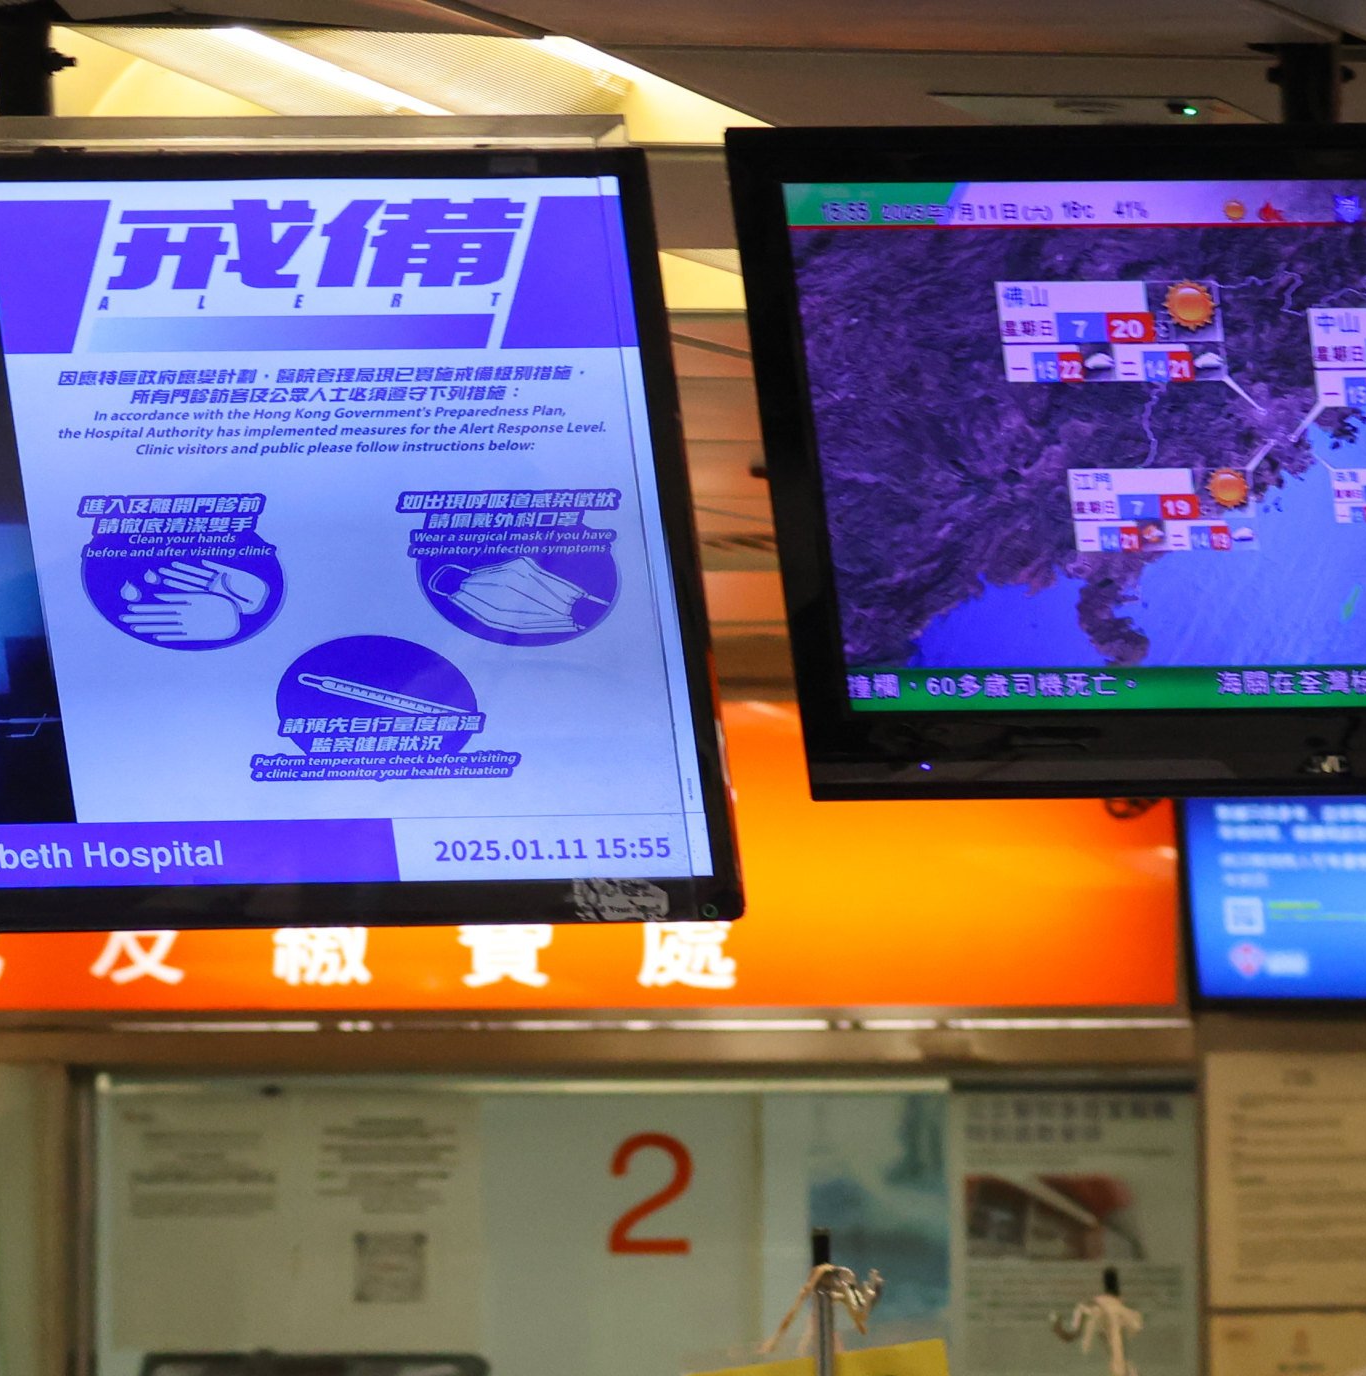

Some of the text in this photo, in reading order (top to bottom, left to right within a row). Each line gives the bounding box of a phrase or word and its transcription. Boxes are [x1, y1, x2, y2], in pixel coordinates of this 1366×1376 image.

[107, 197, 527, 292] 戒備
[1070, 319, 1088, 338] 7
[1109, 319, 1145, 338] 20
[94, 405, 567, 423] In accordance with the Hong Kong Government's Preparedness Plan,
[58, 421, 607, 441] the Hospital Authority has implemented measures for the Alert Response Level.
[135, 439, 535, 456] Clinic visitors and public please follow instructions below:
[81, 496, 262, 515] 進入及離開門診前
[1130, 500, 1144, 517] 7
[1162, 499, 1190, 517] 19
[97, 515, 253, 534] 請徹底清潔雙手
[128, 532, 236, 546] Clean your hands
[413, 529, 612, 544] Wear a surgical mask if you have
[86, 545, 272, 559] before and after visiting clinic
[412, 543, 607, 557] respiratory infection symptoms
[282, 715, 481, 734] 請預先自行量度體溫
[310, 735, 443, 753] 監察健康狀況
[254, 751, 516, 768] Perform temperature check before visiting
[255, 765, 509, 780] a clinic and monitor your health situation
[83, 838, 224, 877] Hospital
[434, 835, 671, 864] 2025.01.11 15:55
[608, 1131, 695, 1256] 2
